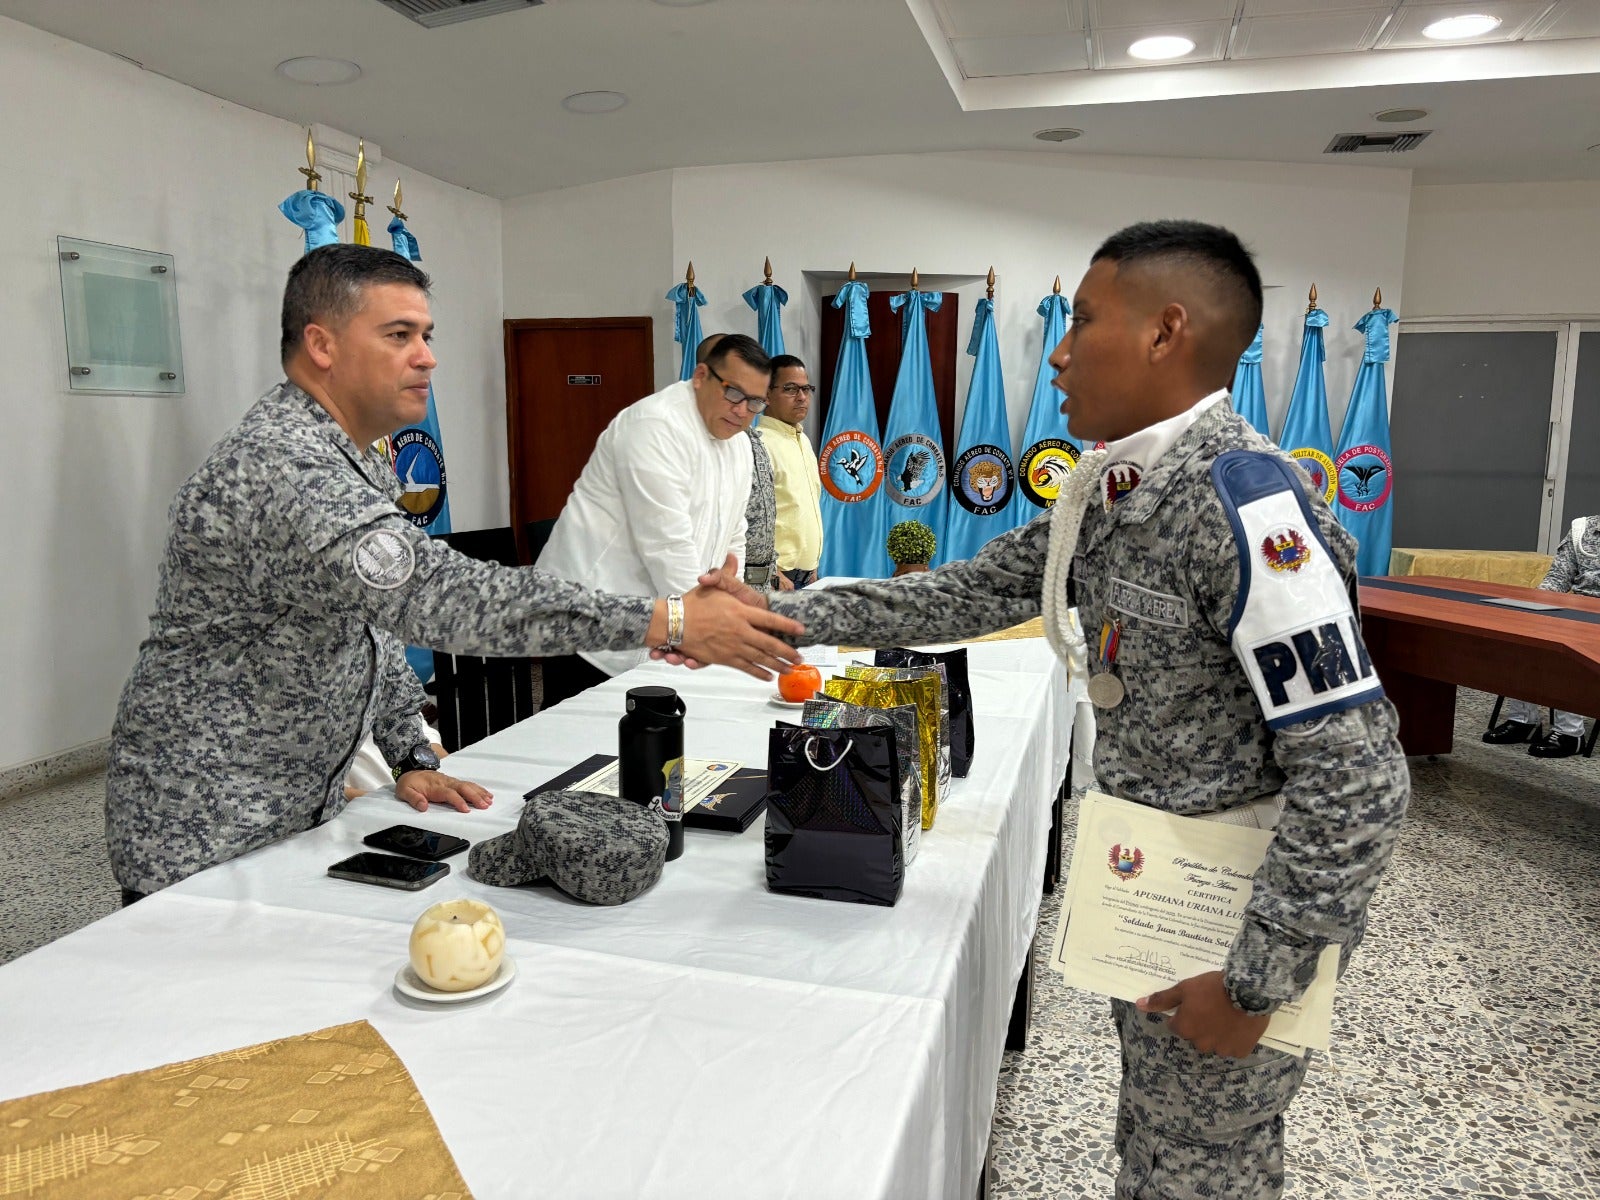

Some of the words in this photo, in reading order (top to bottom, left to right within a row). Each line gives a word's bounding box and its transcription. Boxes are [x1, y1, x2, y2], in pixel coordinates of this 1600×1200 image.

[416, 432, 423, 442] DE
[424, 438, 443, 468] COMBATE
[820, 446, 832, 475] COMANDO
[862, 437, 882, 460] COMBATE
[916, 436, 924, 444] DE
[925, 440, 944, 465] COMBATE
[1020, 446, 1038, 477] COMANDO
[1038, 440, 1061, 450] AÉREO
[1062, 442, 1072, 452] DE
[1315, 452, 1323, 460] DE
[953, 460, 966, 487] COMANDO
[984, 446, 992, 454] DE
[992, 448, 1011, 468] COMBATE
[903, 498, 922, 506] FAC
[973, 506, 997, 515] FAC
[1355, 503, 1376, 511] FAC
[412, 516, 428, 526] FAC
[1132, 889, 1184, 908] APUSHANA
[1186, 901, 1225, 917] URIANA
[1187, 889, 1232, 905] CERTIFICA
[1156, 923, 1176, 936] Juan
[1178, 928, 1214, 944] Bautista
